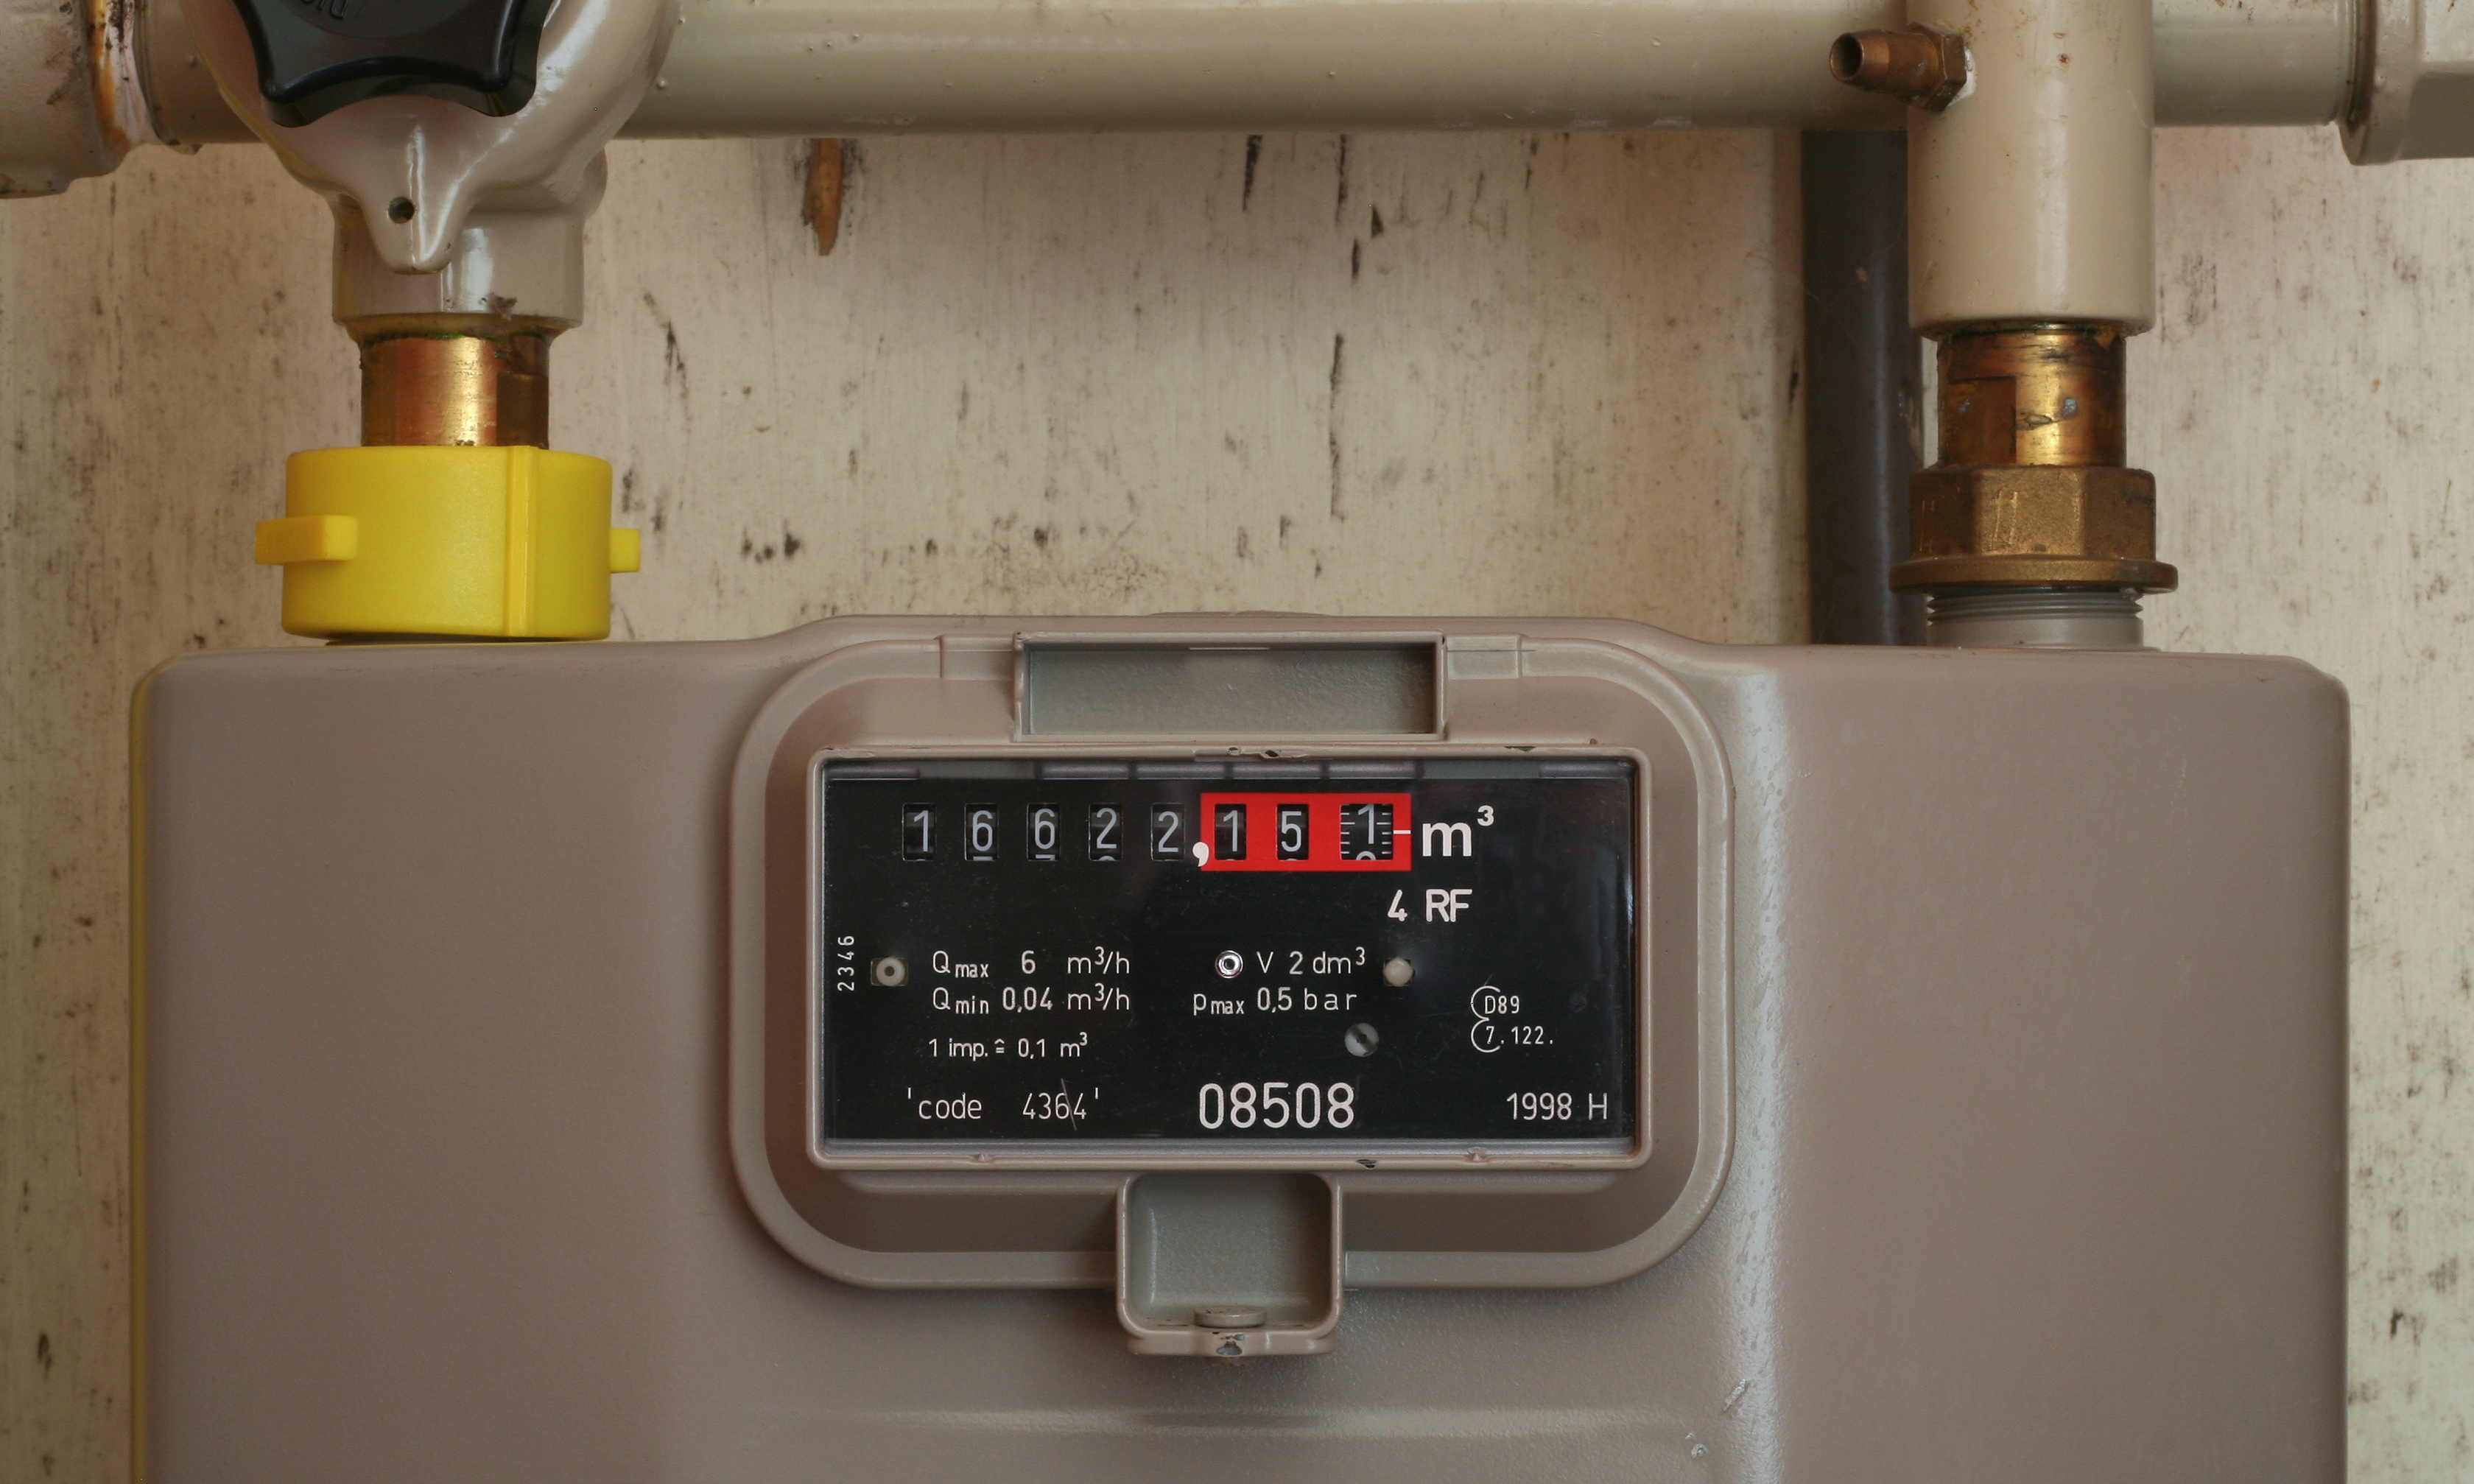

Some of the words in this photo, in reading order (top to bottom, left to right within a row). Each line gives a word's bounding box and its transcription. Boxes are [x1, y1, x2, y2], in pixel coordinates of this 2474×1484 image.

[1387, 889, 1408, 922] 4
[1425, 888, 1473, 923] RF
[837, 935, 855, 991] 2346
[932, 950, 989, 979] Qmax
[1021, 950, 1036, 974] 6
[1257, 951, 1274, 974] V
[1289, 951, 1303, 975] 2
[932, 987, 989, 1015] Qmin
[1002, 986, 1053, 1013] 0,04
[1257, 986, 1293, 1013] 0,5
[1304, 987, 1357, 1010] bar
[1484, 995, 1519, 1014] D89
[928, 1038, 937, 1058] 1
[949, 1038, 988, 1062] imp.
[1018, 1038, 1045, 1060] 0,1
[1199, 1082, 1354, 1130] 08508
[1506, 1092, 1572, 1120] 1998
[1588, 1092, 1607, 1120] H
